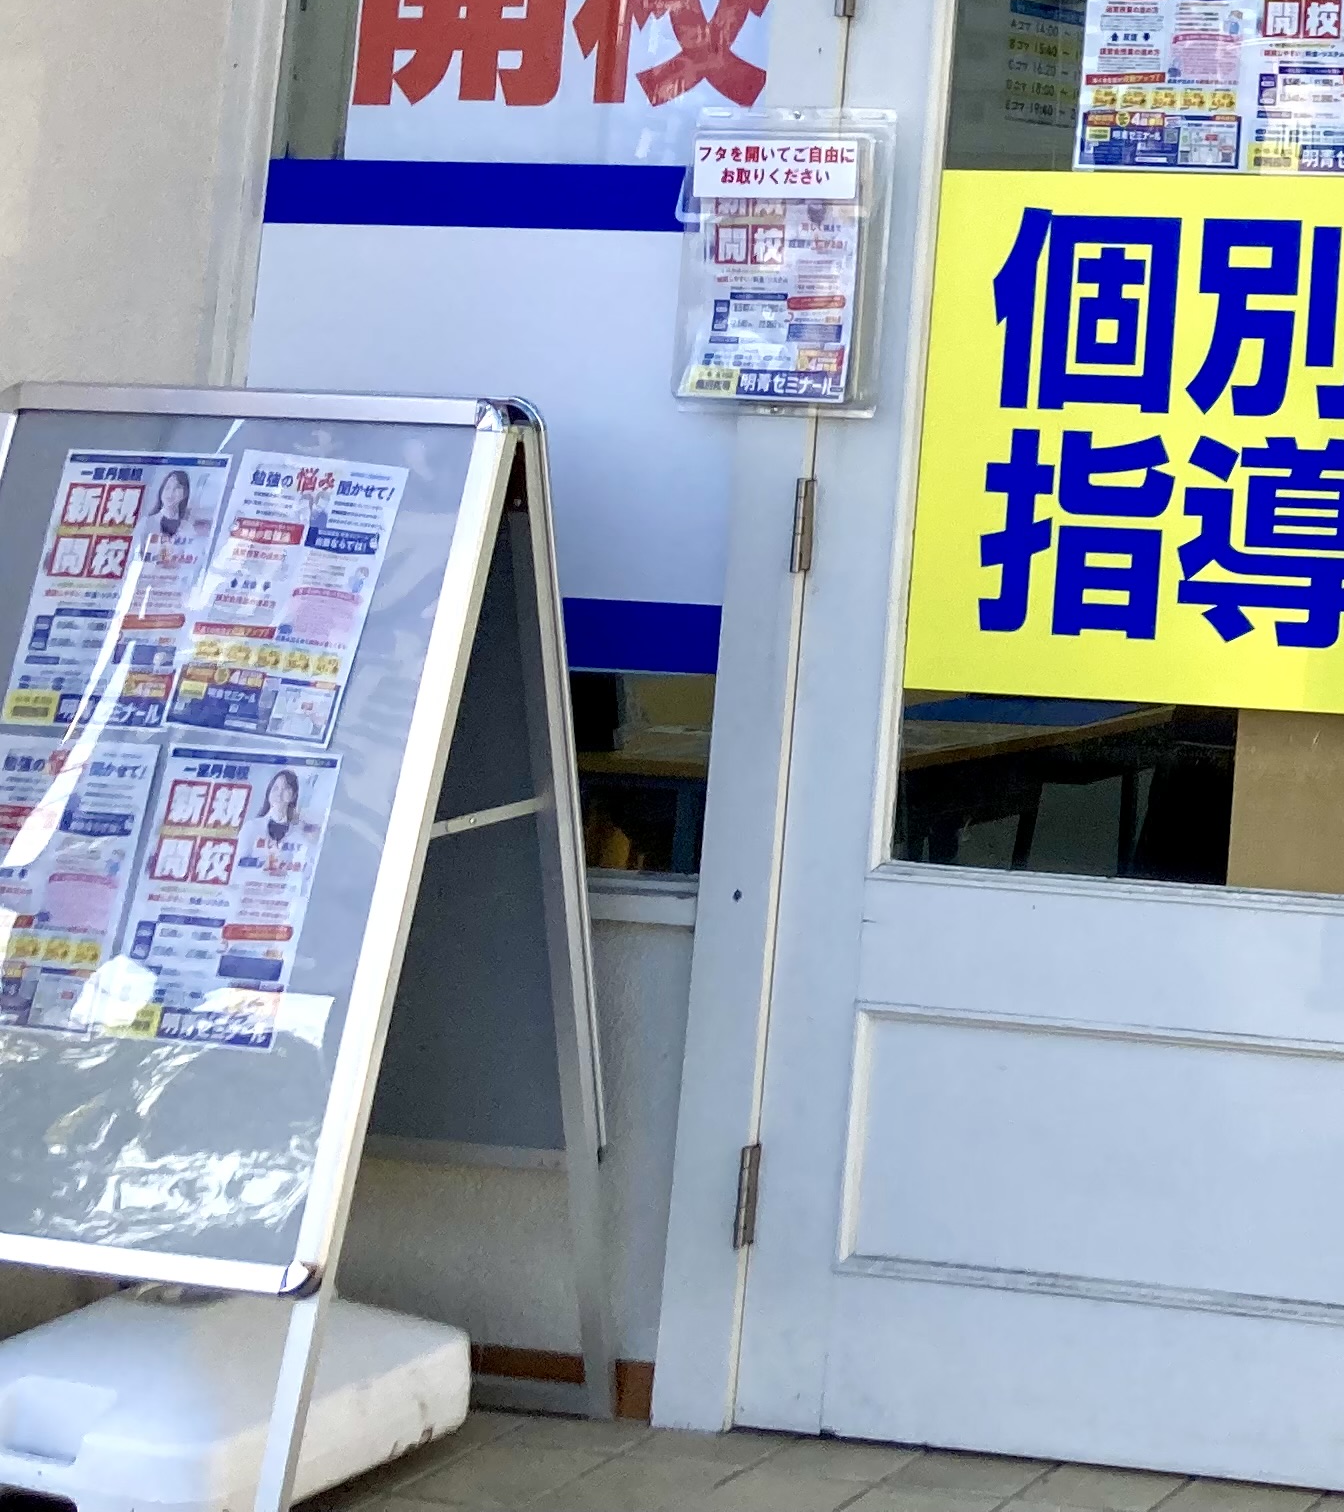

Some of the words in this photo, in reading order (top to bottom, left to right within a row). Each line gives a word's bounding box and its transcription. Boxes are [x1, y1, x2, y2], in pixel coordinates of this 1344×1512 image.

[699, 146, 855, 164] フタを開いてご自由に
[720, 167, 831, 185] お取りください
[740, 372, 832, 395] 明青ゼミナール
